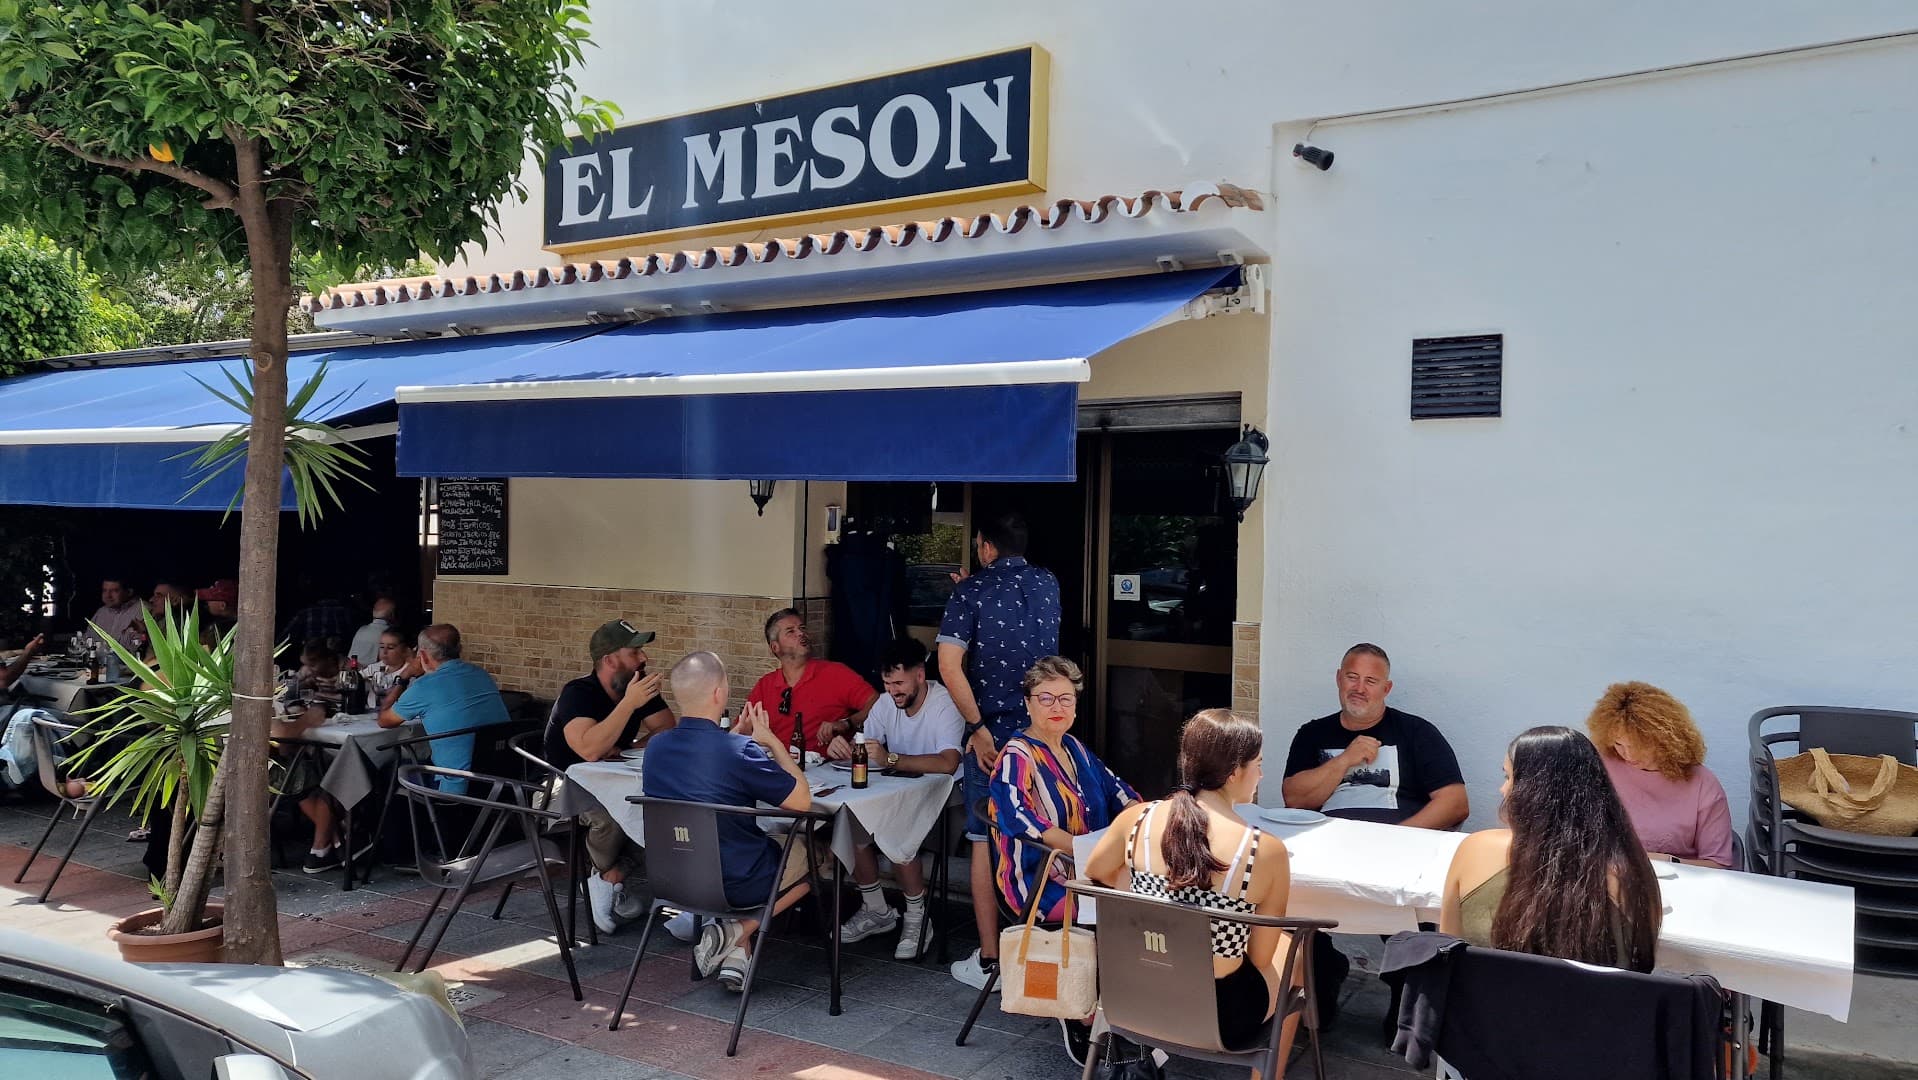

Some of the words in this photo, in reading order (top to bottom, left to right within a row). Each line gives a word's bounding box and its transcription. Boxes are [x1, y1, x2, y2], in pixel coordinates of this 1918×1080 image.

[558, 147, 655, 227] EL
[682, 75, 1014, 209] MESON
[1144, 931, 1168, 953] m
